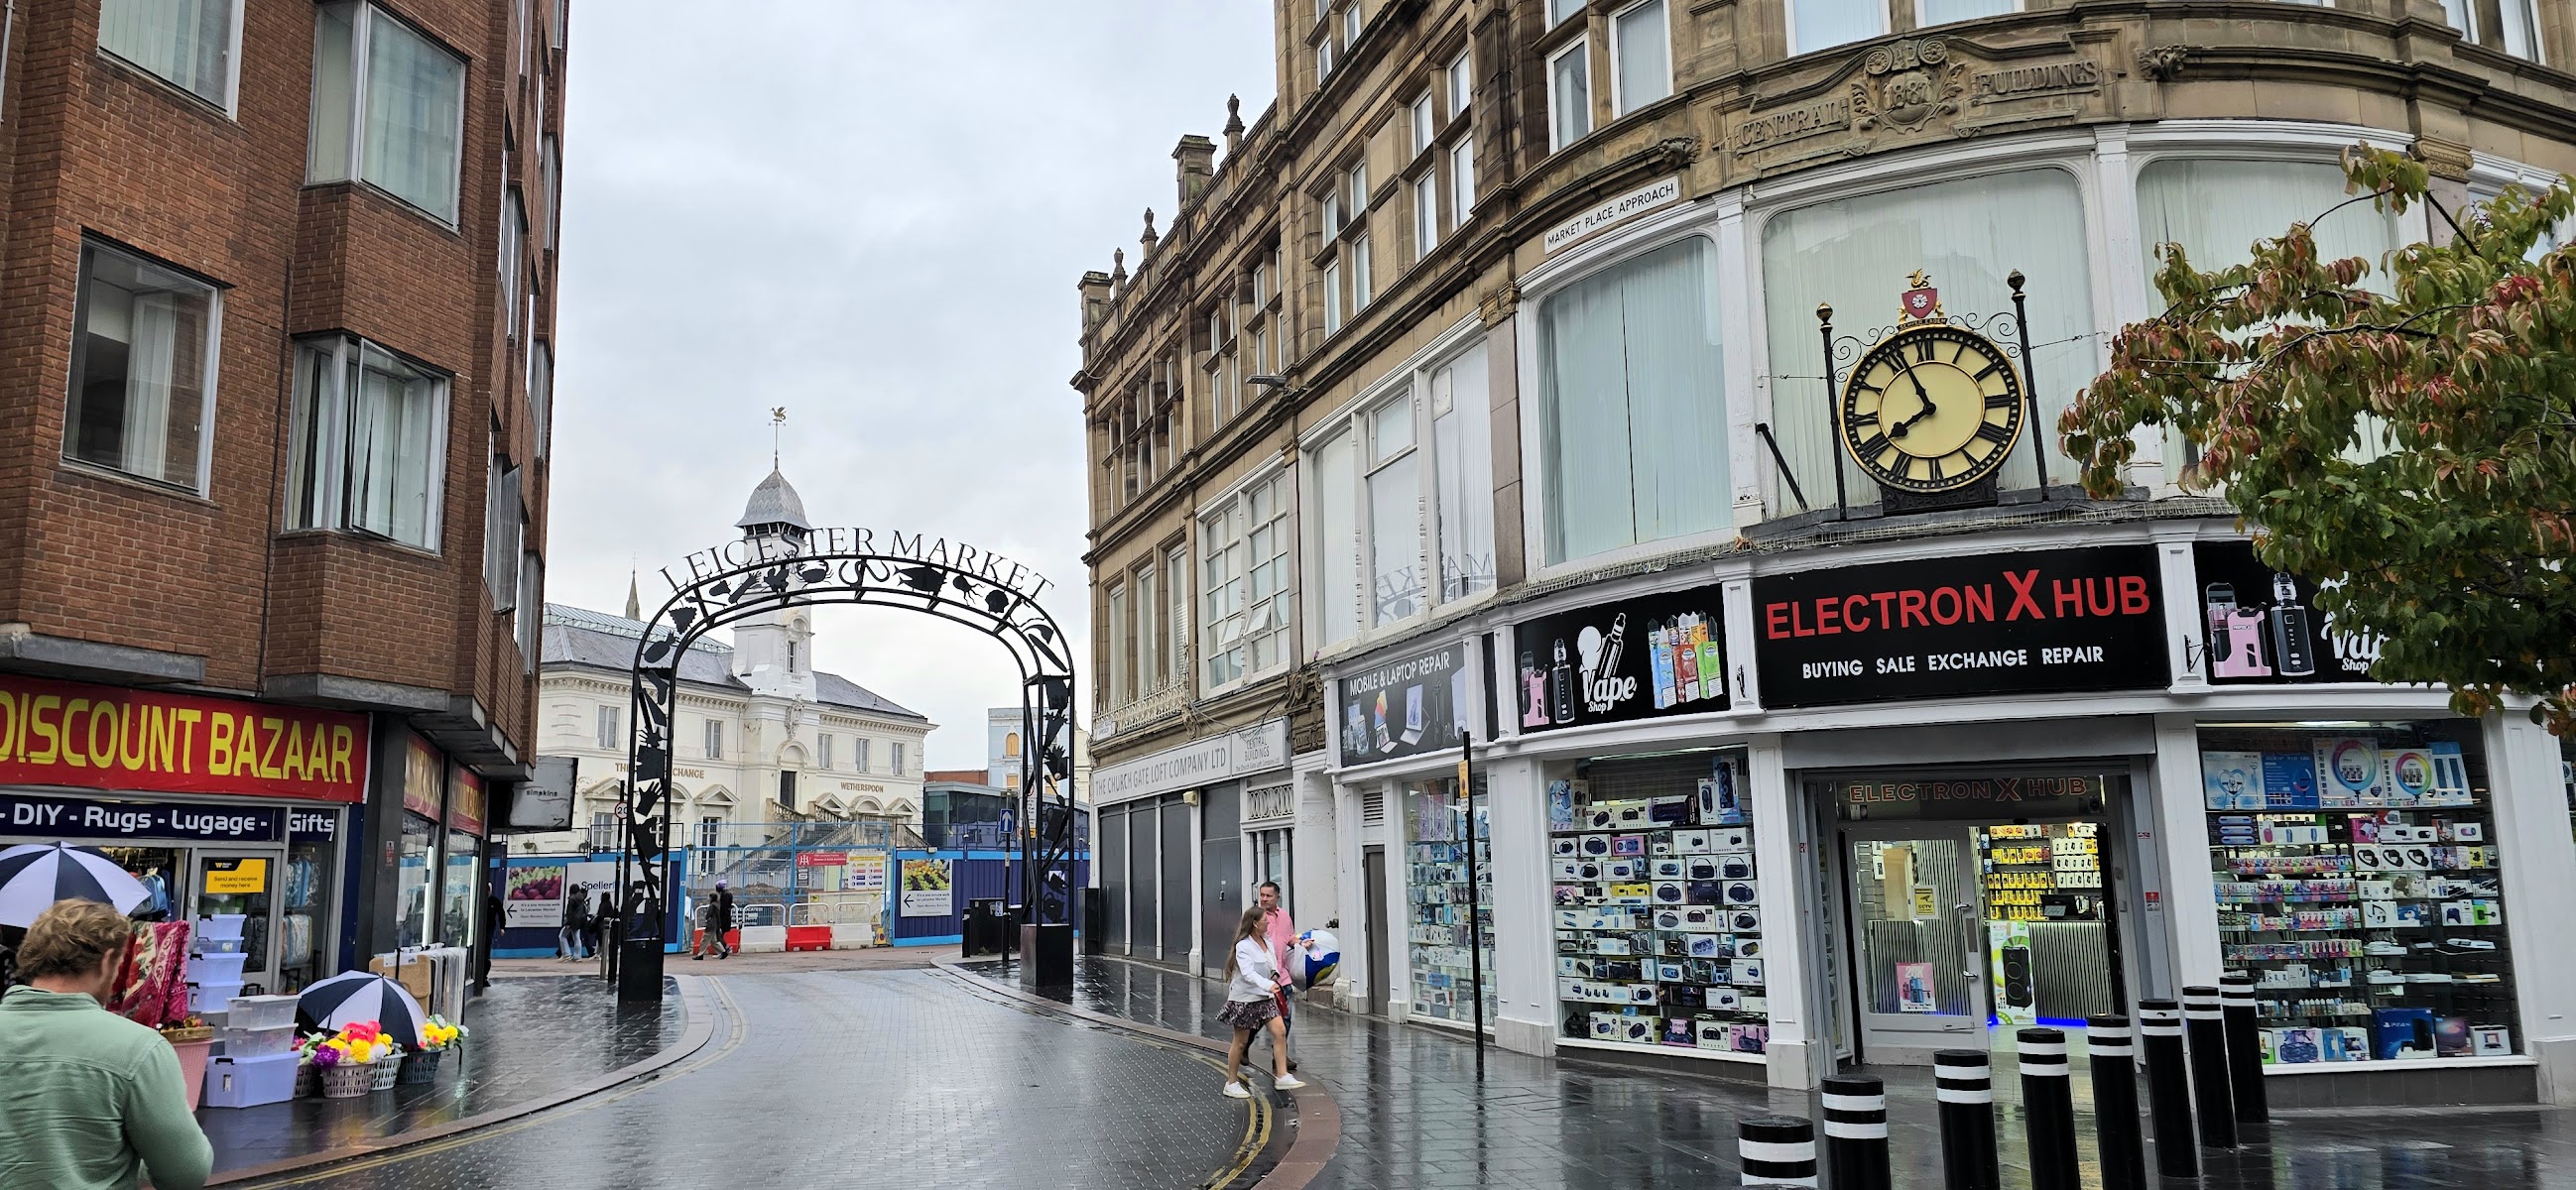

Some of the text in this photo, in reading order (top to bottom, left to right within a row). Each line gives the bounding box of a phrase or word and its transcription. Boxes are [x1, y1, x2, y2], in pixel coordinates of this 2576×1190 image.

[1979, 60, 2099, 95] BUILDINGS
[1740, 102, 1842, 146] CENTRAL
[1547, 182, 1674, 247] MARKET PLACE APPROACH
[658, 528, 1054, 601] LEICESTER MARKET
[1766, 569, 2150, 640] ELECTRON X HUB
[1350, 651, 1450, 696] MOBILE & LAPTOP REPAIR
[1802, 646, 2104, 678] BUYING SALE EXCHANGE REPAIR
[2342, 657, 2369, 674] Shop
[1582, 669, 1637, 711] Vape
[1588, 700, 1607, 714] Shop
[208, 711, 353, 784] BAZAAR
[1244, 746, 1270, 762] BUILDINGS
[840, 781, 884, 793] WETHERSPOON
[1095, 747, 1226, 796] THE CHURCH GATE LOFT COMPANY LTD
[1849, 776, 2088, 803] ELECTRON X HUB
[13, 802, 64, 825] DIY
[84, 806, 152, 832] Rugs
[171, 809, 256, 835] Lugage
[290, 813, 335, 833] Gifts
